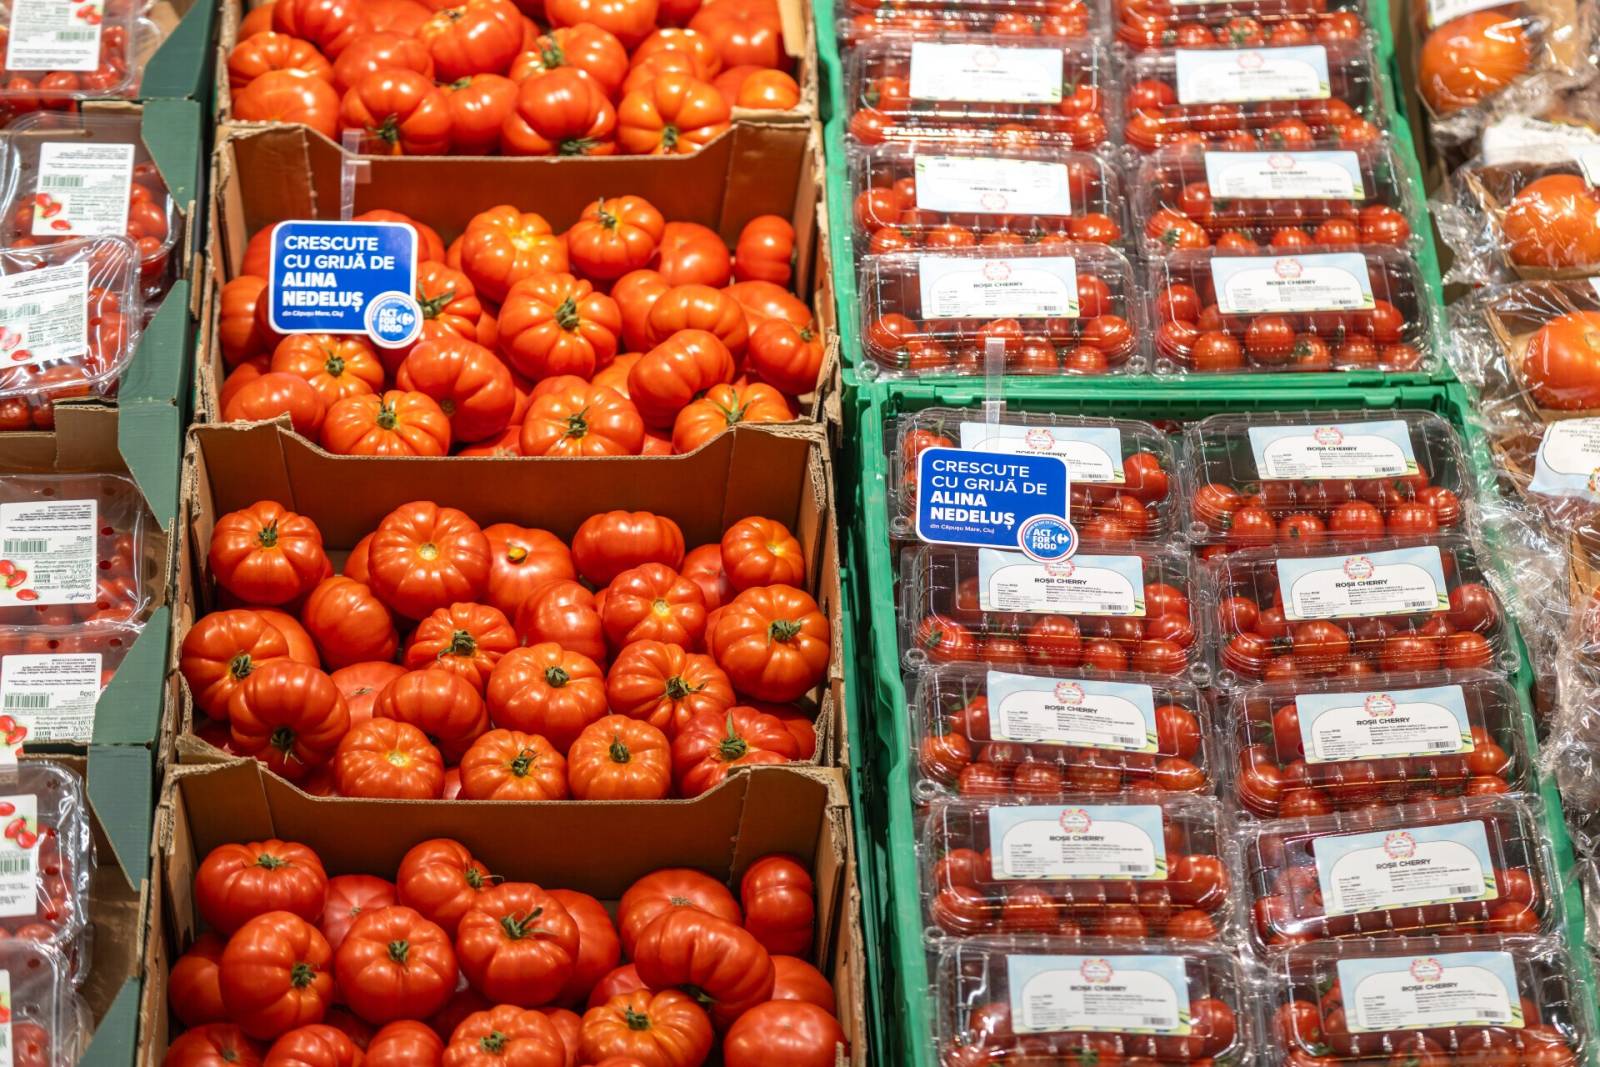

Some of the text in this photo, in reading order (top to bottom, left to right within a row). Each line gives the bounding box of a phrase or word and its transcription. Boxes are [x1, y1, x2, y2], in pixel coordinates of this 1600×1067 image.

[284, 236, 378, 251] CRESCUTE
[283, 252, 395, 270] CU GRIJĂ DE
[282, 272, 337, 287] ALINA
[282, 291, 364, 312] NEDELUȘ
[380, 309, 398, 317] ACT
[379, 324, 403, 332] FOOD
[932, 459, 1030, 478] CRESCUTE
[931, 476, 1047, 495] CU GRIJĂ DE
[930, 490, 987, 507] ALINA
[930, 507, 1015, 530] NEDELUȘ
